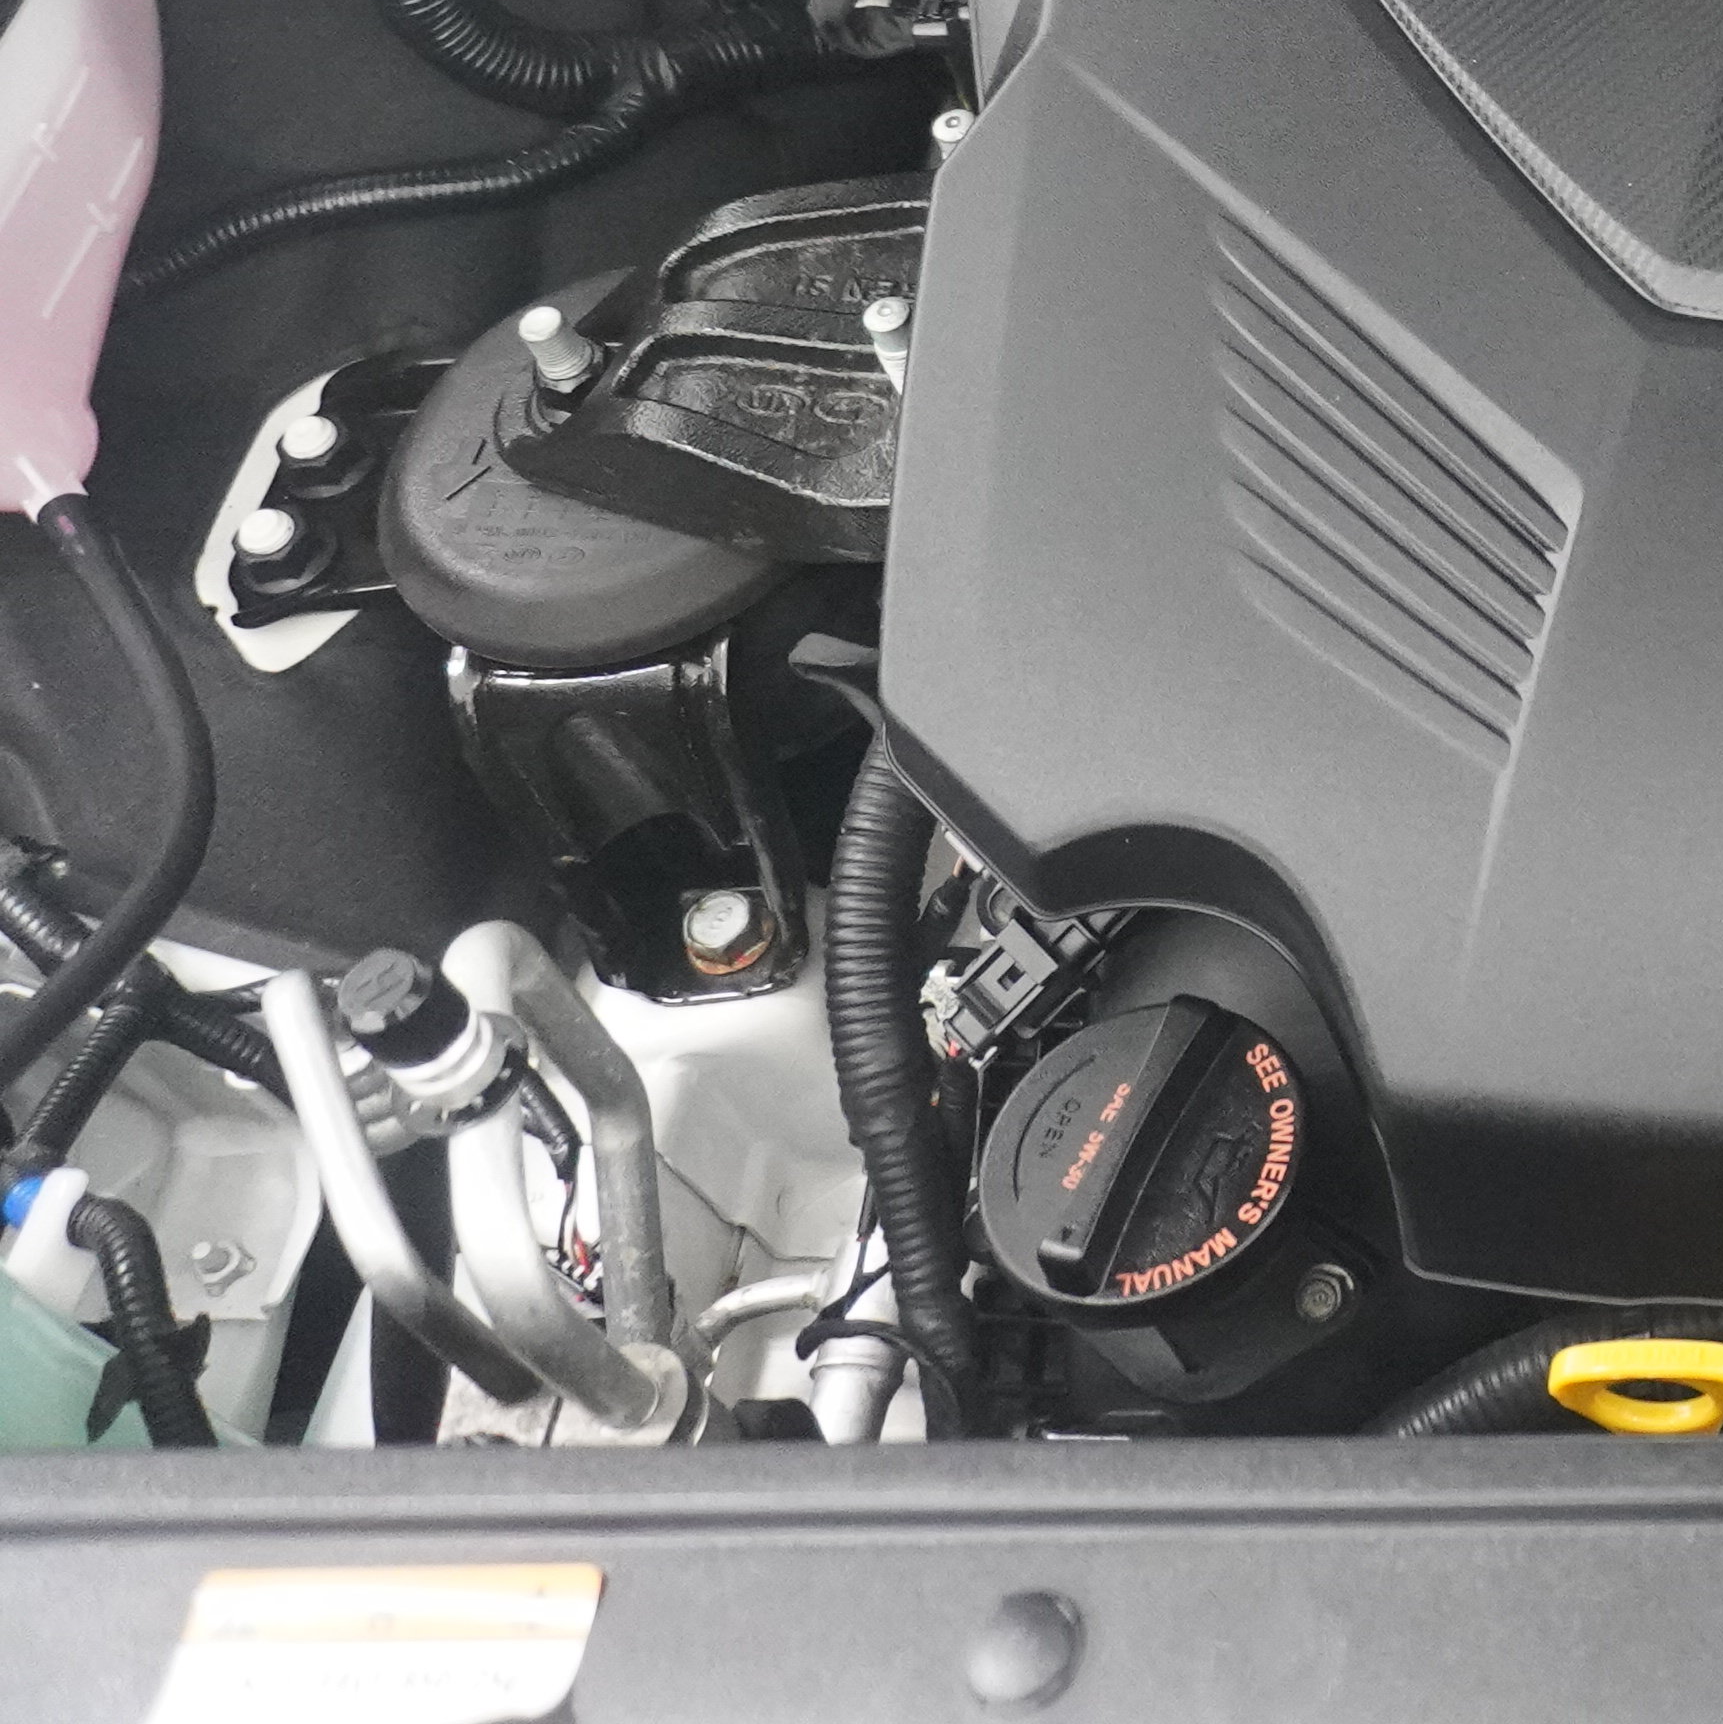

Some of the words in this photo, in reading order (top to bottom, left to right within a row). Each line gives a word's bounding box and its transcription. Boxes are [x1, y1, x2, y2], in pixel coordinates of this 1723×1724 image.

[1246, 1043, 1288, 1093] SEE
[1237, 1098, 1295, 1226] OWNER'S
[1116, 1226, 1238, 1298] MANUAL
